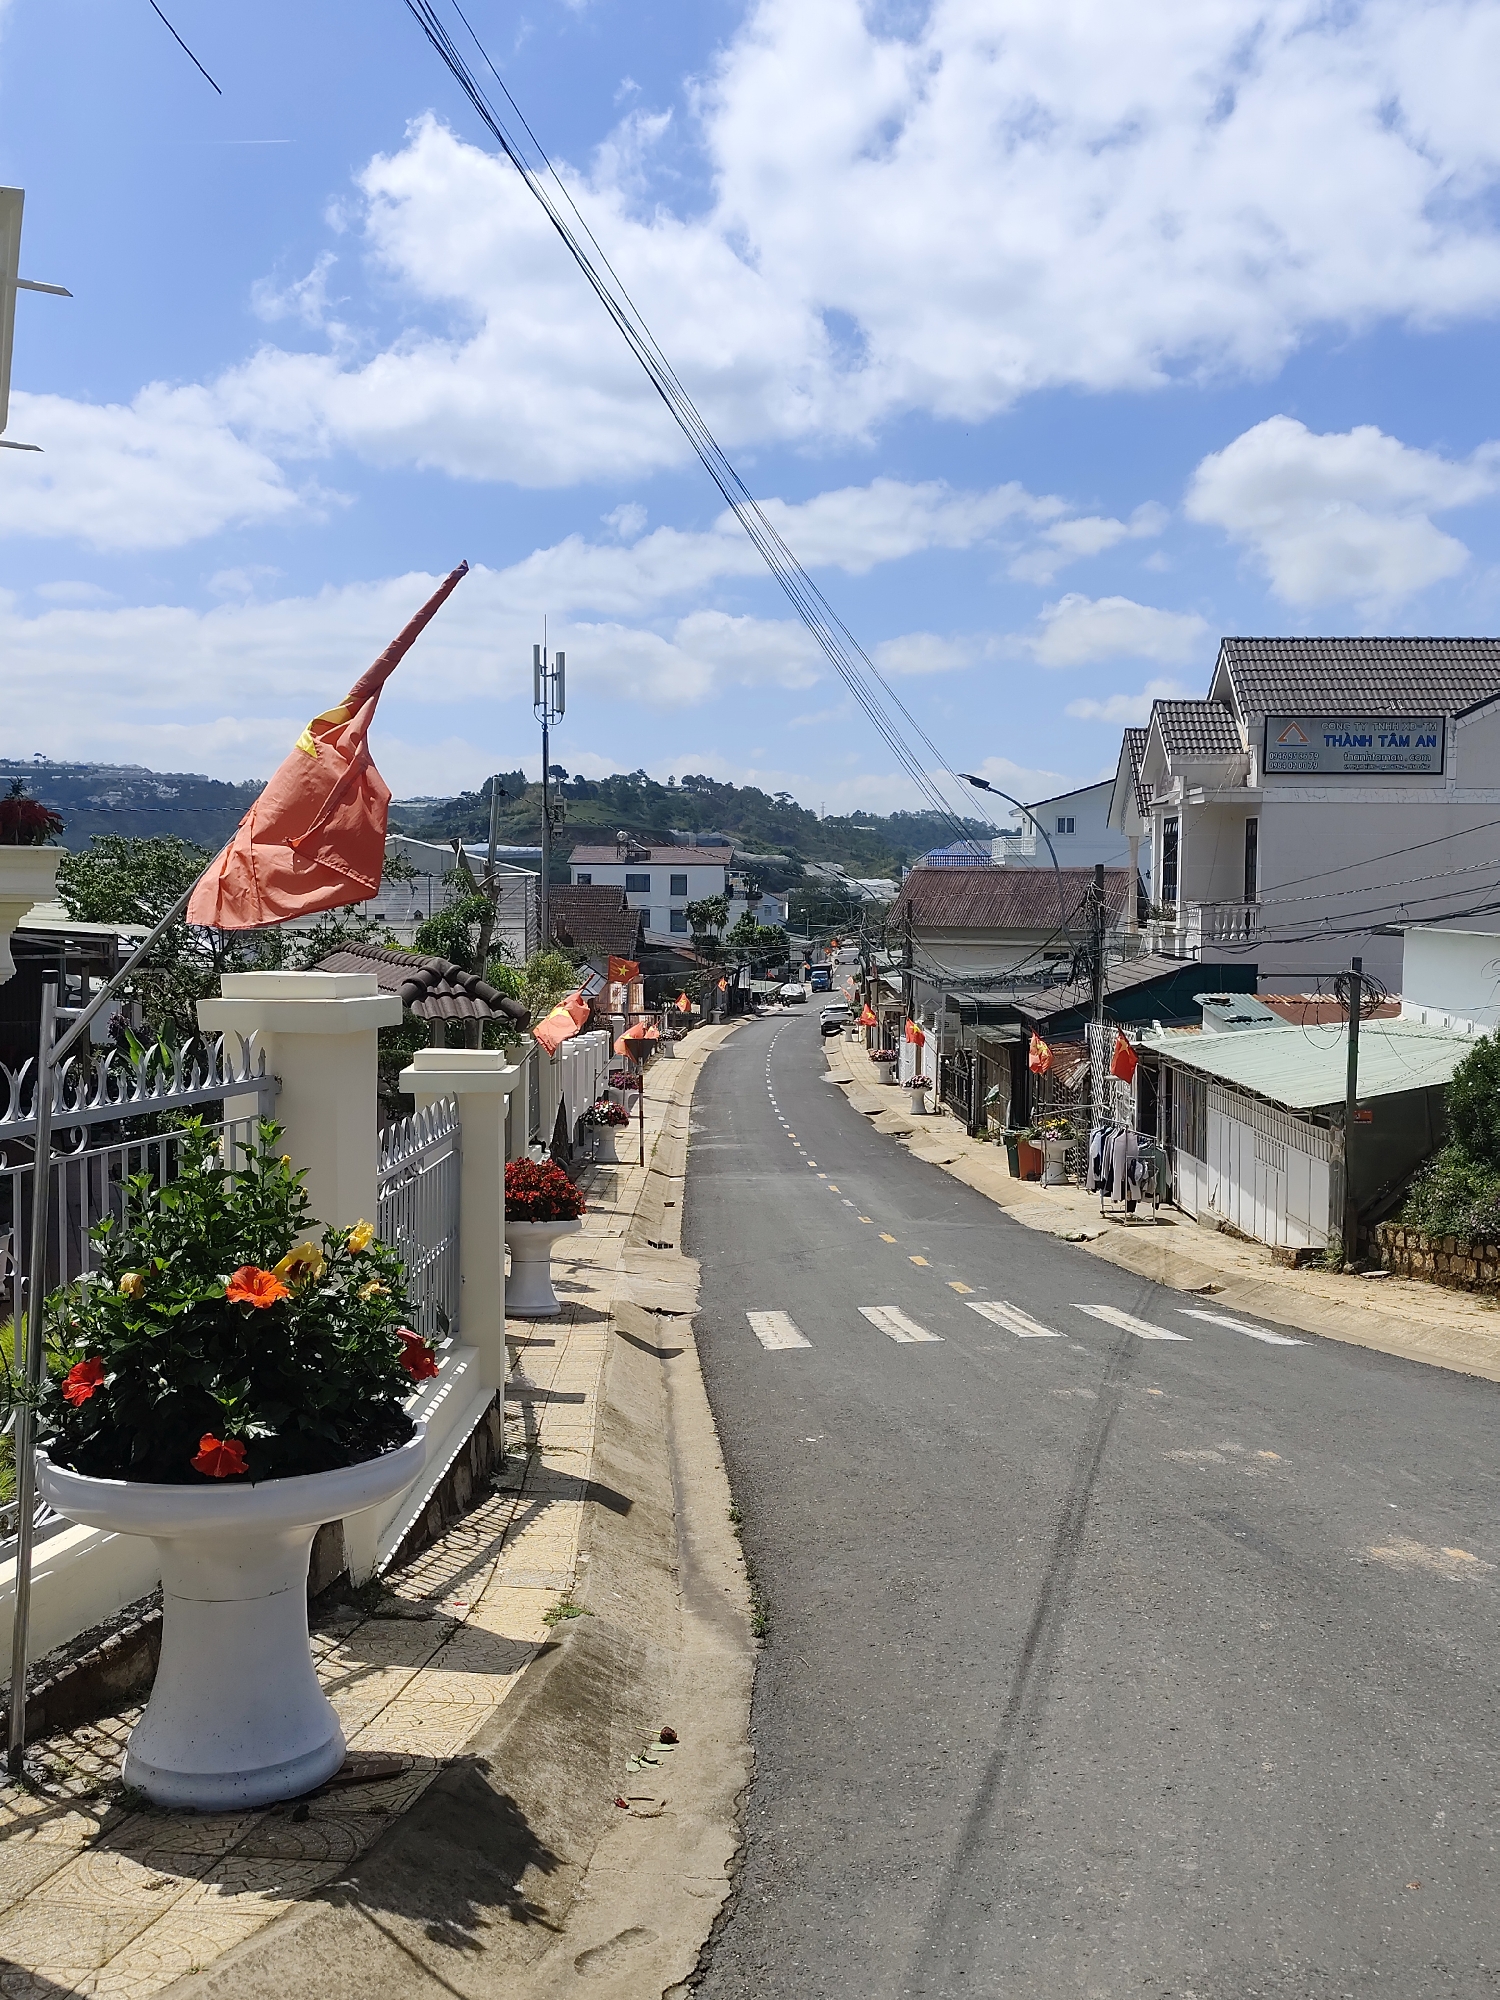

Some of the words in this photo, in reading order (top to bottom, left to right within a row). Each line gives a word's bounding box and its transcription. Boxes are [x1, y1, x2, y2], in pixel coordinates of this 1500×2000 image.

[1321, 720, 1351, 731] CÔNG
[1354, 722, 1368, 731] TY
[1373, 722, 1399, 731] TNHH
[1323, 732, 1372, 747] THÀNH
[1378, 732, 1409, 747] TÂM
[1415, 735, 1437, 747] AN
